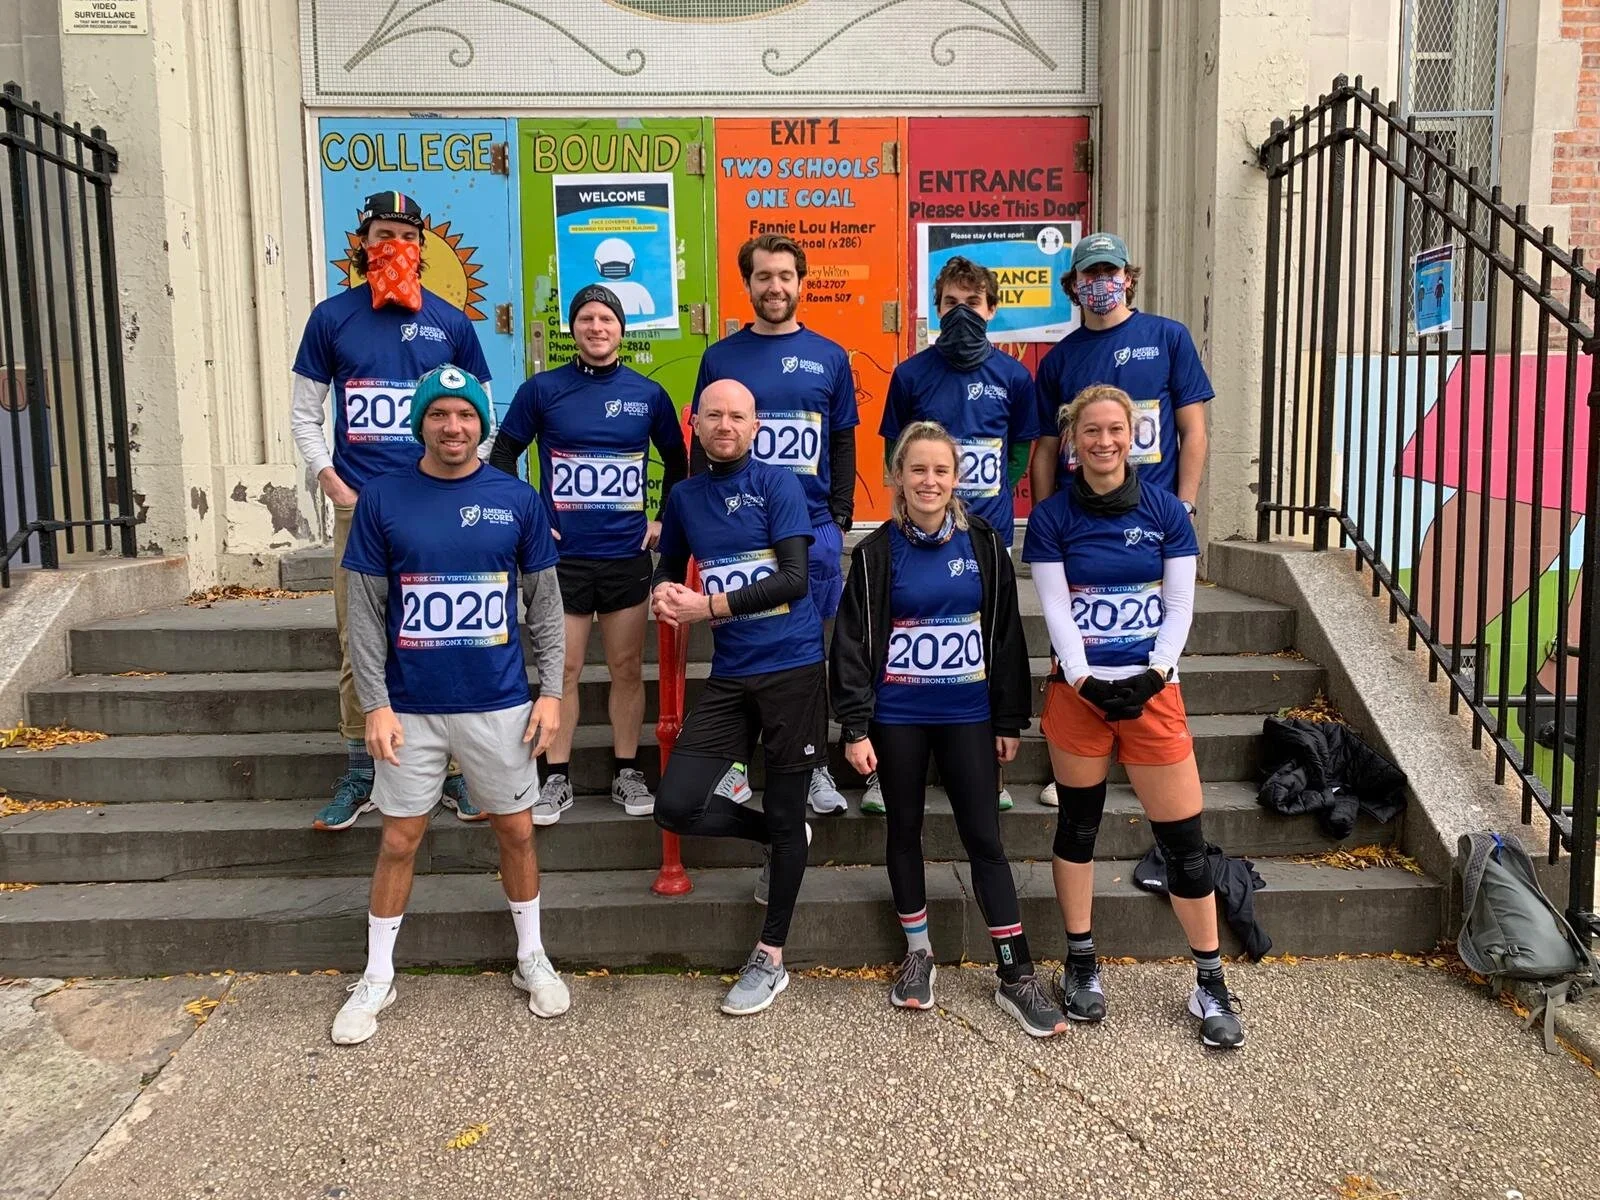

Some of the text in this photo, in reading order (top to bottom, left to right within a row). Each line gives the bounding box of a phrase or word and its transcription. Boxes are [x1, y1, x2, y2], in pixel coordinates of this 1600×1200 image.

[92, 2, 117, 10] VIDEO
[74, 11, 136, 19] SURVEILLANCE
[771, 118, 840, 145] EXIT 1
[321, 132, 681, 173] COLLEGE BOUND
[721, 156, 880, 179] TWO SCHOOLS
[919, 167, 1064, 193] ENTRANCE
[579, 191, 646, 203] WELCOME
[745, 188, 856, 208] ONE GOAL
[909, 198, 1087, 218] Please Use This Door
[749, 219, 876, 235] Fannie Lou Hamer
[950, 232, 972, 240] Please
[972, 232, 986, 241] stay
[1007, 231, 1025, 240] apart
[806, 292, 833, 303] Room
[390, 380, 415, 388] VIRTUAL
[348, 394, 414, 428] 202
[754, 425, 818, 461] 020
[959, 451, 998, 484] 20
[554, 463, 641, 497] 2020
[482, 507, 513, 515] AMERICA
[482, 512, 514, 522] SCORES
[717, 556, 740, 564] VIRTUAL
[1107, 585, 1136, 593] VIRTUAL
[402, 590, 504, 632] 2020
[1071, 594, 1164, 631] 2020
[934, 616, 962, 624] VIRTUAL
[400, 639, 419, 647] FROM
[419, 639, 434, 647] THE
[435, 639, 462, 647] BRONX
[888, 629, 982, 670] 2020
[886, 675, 907, 683] FROM
